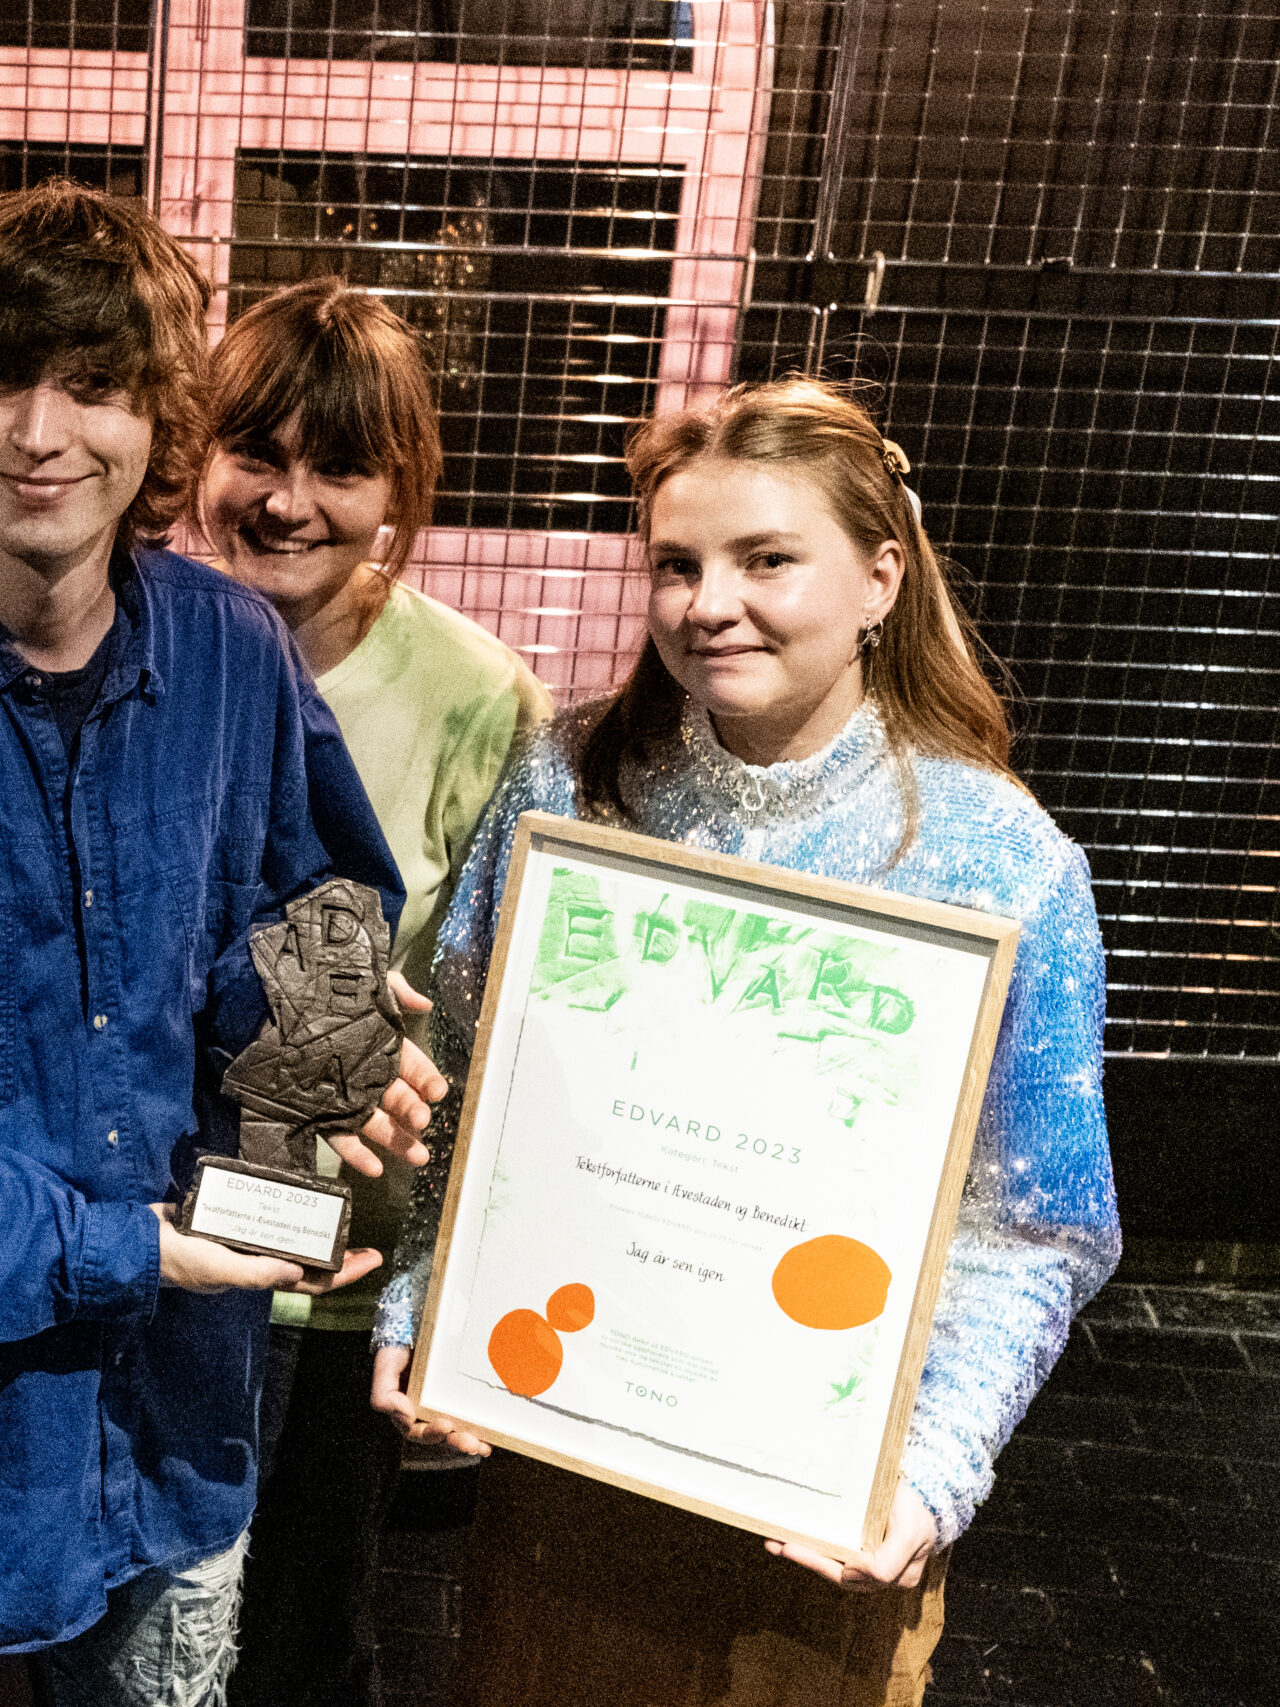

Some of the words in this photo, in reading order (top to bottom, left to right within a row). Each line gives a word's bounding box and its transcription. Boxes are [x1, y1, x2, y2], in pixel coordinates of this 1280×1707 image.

[563, 901, 916, 1035] EDVARD
[612, 1099, 721, 1142] EDVARD
[735, 1132, 803, 1165] 2023
[712, 1158, 740, 1174] Tekst
[227, 1178, 282, 1199] EDVARD
[285, 1192, 319, 1208] 2023
[575, 1155, 661, 1186] Tekstforfatterne
[664, 1180, 670, 1193] i
[672, 1183, 732, 1212] Ævestaden
[735, 1204, 748, 1222] og
[751, 1204, 811, 1233] Benedikt
[292, 1225, 301, 1235] og
[626, 1241, 650, 1264] Jag
[672, 1259, 693, 1273] sen
[697, 1262, 725, 1283] igen
[625, 1381, 678, 1407] TONO
